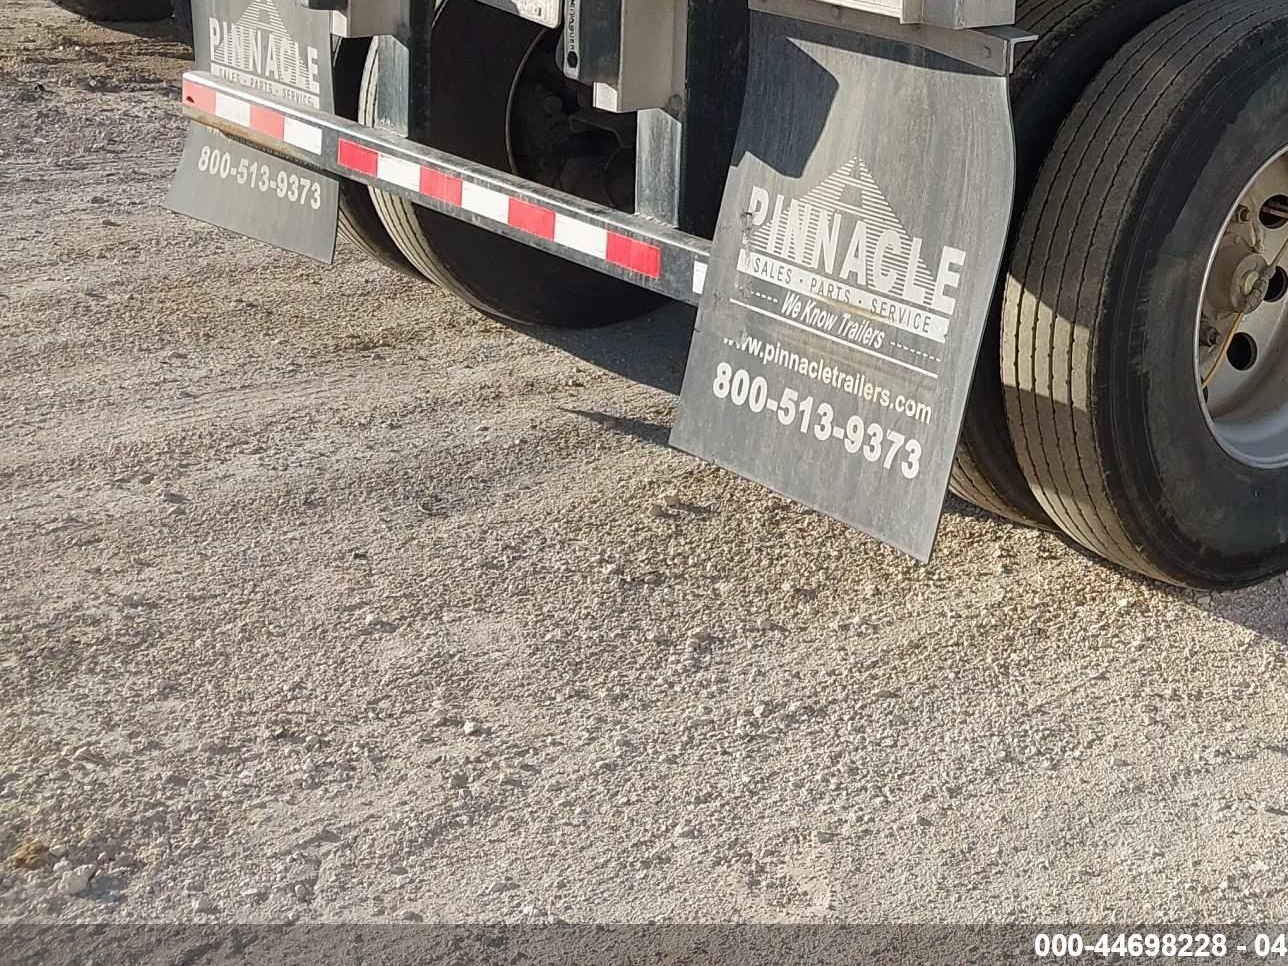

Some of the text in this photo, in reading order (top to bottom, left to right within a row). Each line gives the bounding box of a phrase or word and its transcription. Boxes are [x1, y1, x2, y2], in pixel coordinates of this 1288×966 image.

[209, 17, 320, 94] PINNACLE
[282, 87, 315, 107] SERVICE
[198, 145, 321, 210] 800-513-9373
[742, 185, 967, 316] PINNACLE
[753, 257, 932, 334] SALES PARTS SERVICE
[781, 291, 886, 349] We Know Trailers
[713, 362, 922, 480] 800-513-9373
